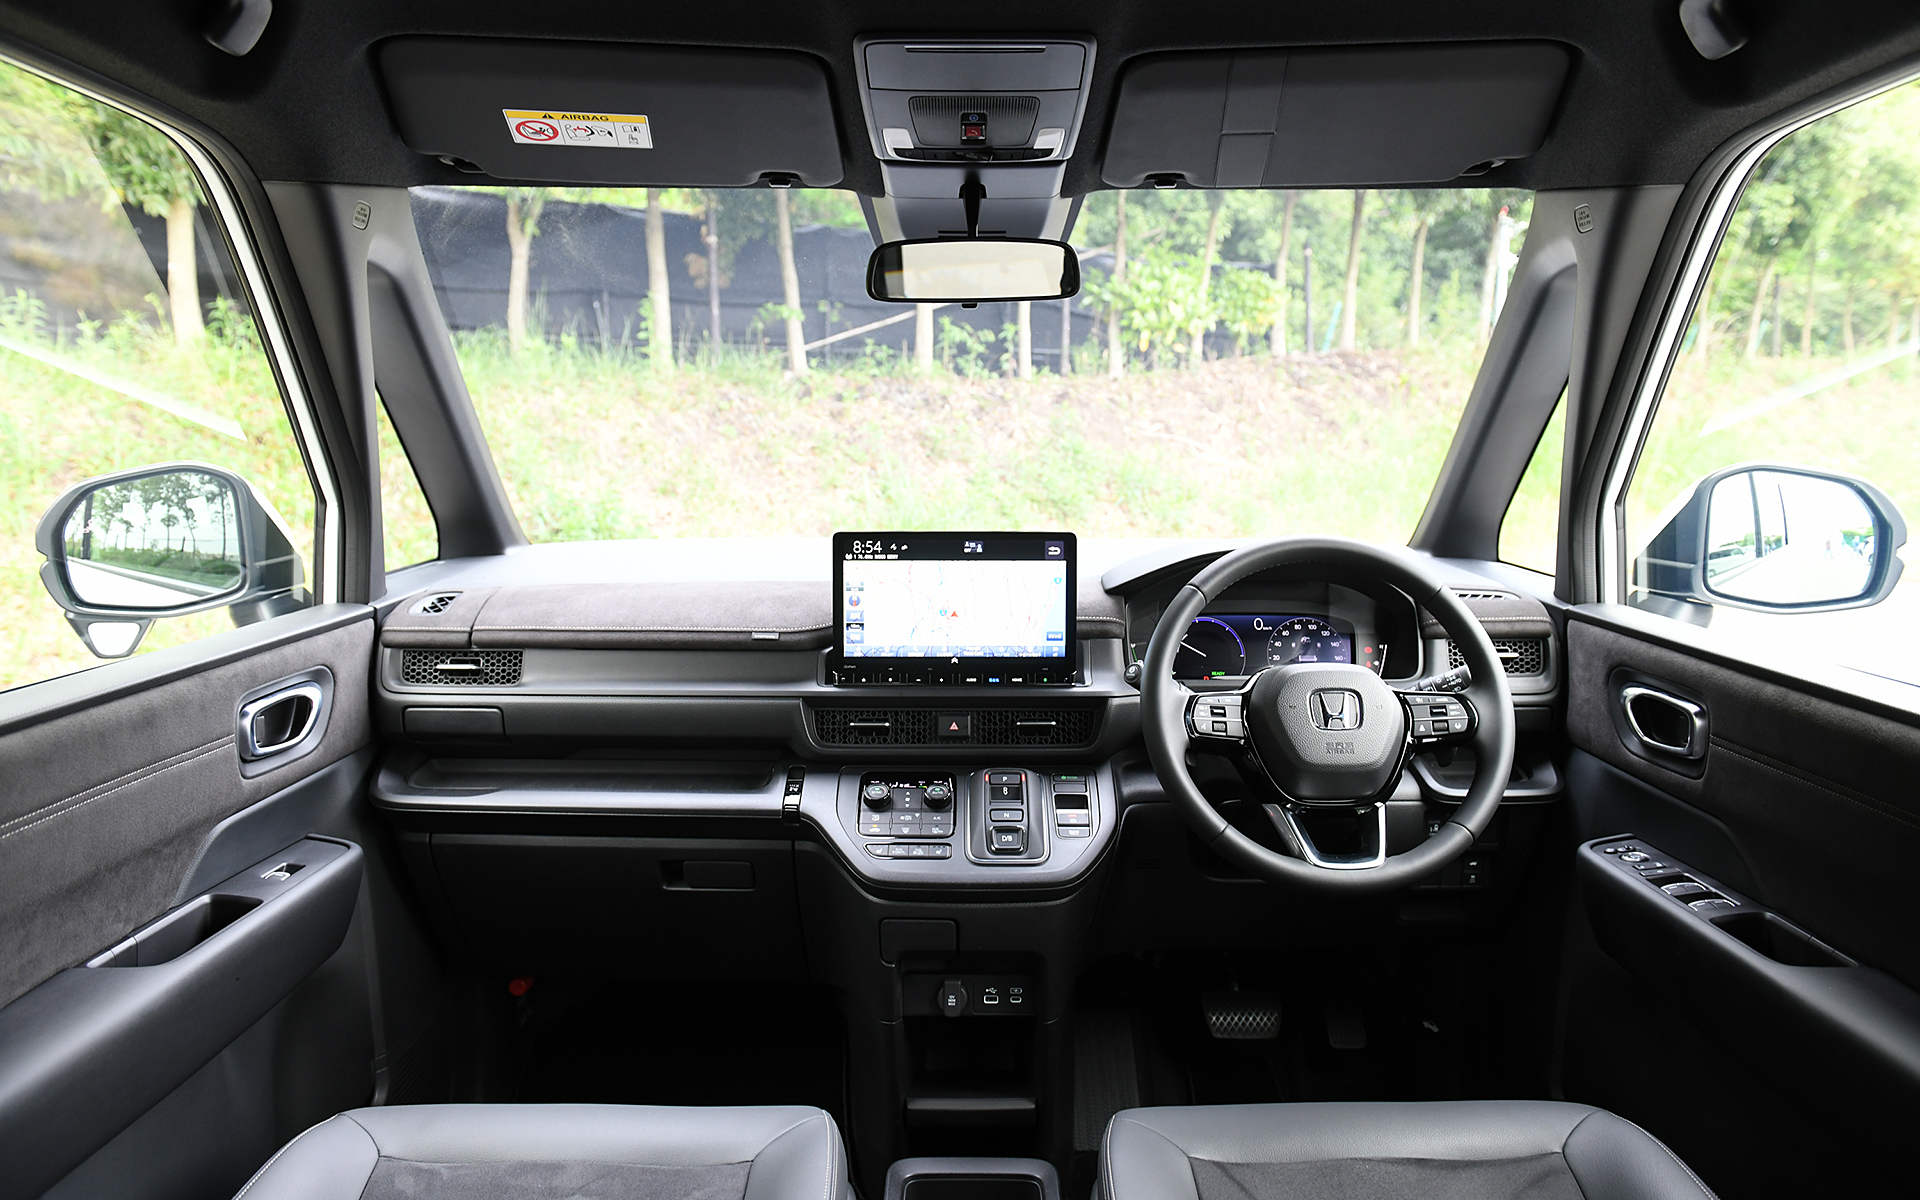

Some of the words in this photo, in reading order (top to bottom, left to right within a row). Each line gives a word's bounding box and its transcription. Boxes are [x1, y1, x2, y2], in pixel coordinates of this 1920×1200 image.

[561, 113, 609, 121] AIRBAG
[852, 540, 883, 554] 8:54
[1253, 617, 1264, 631] 0
